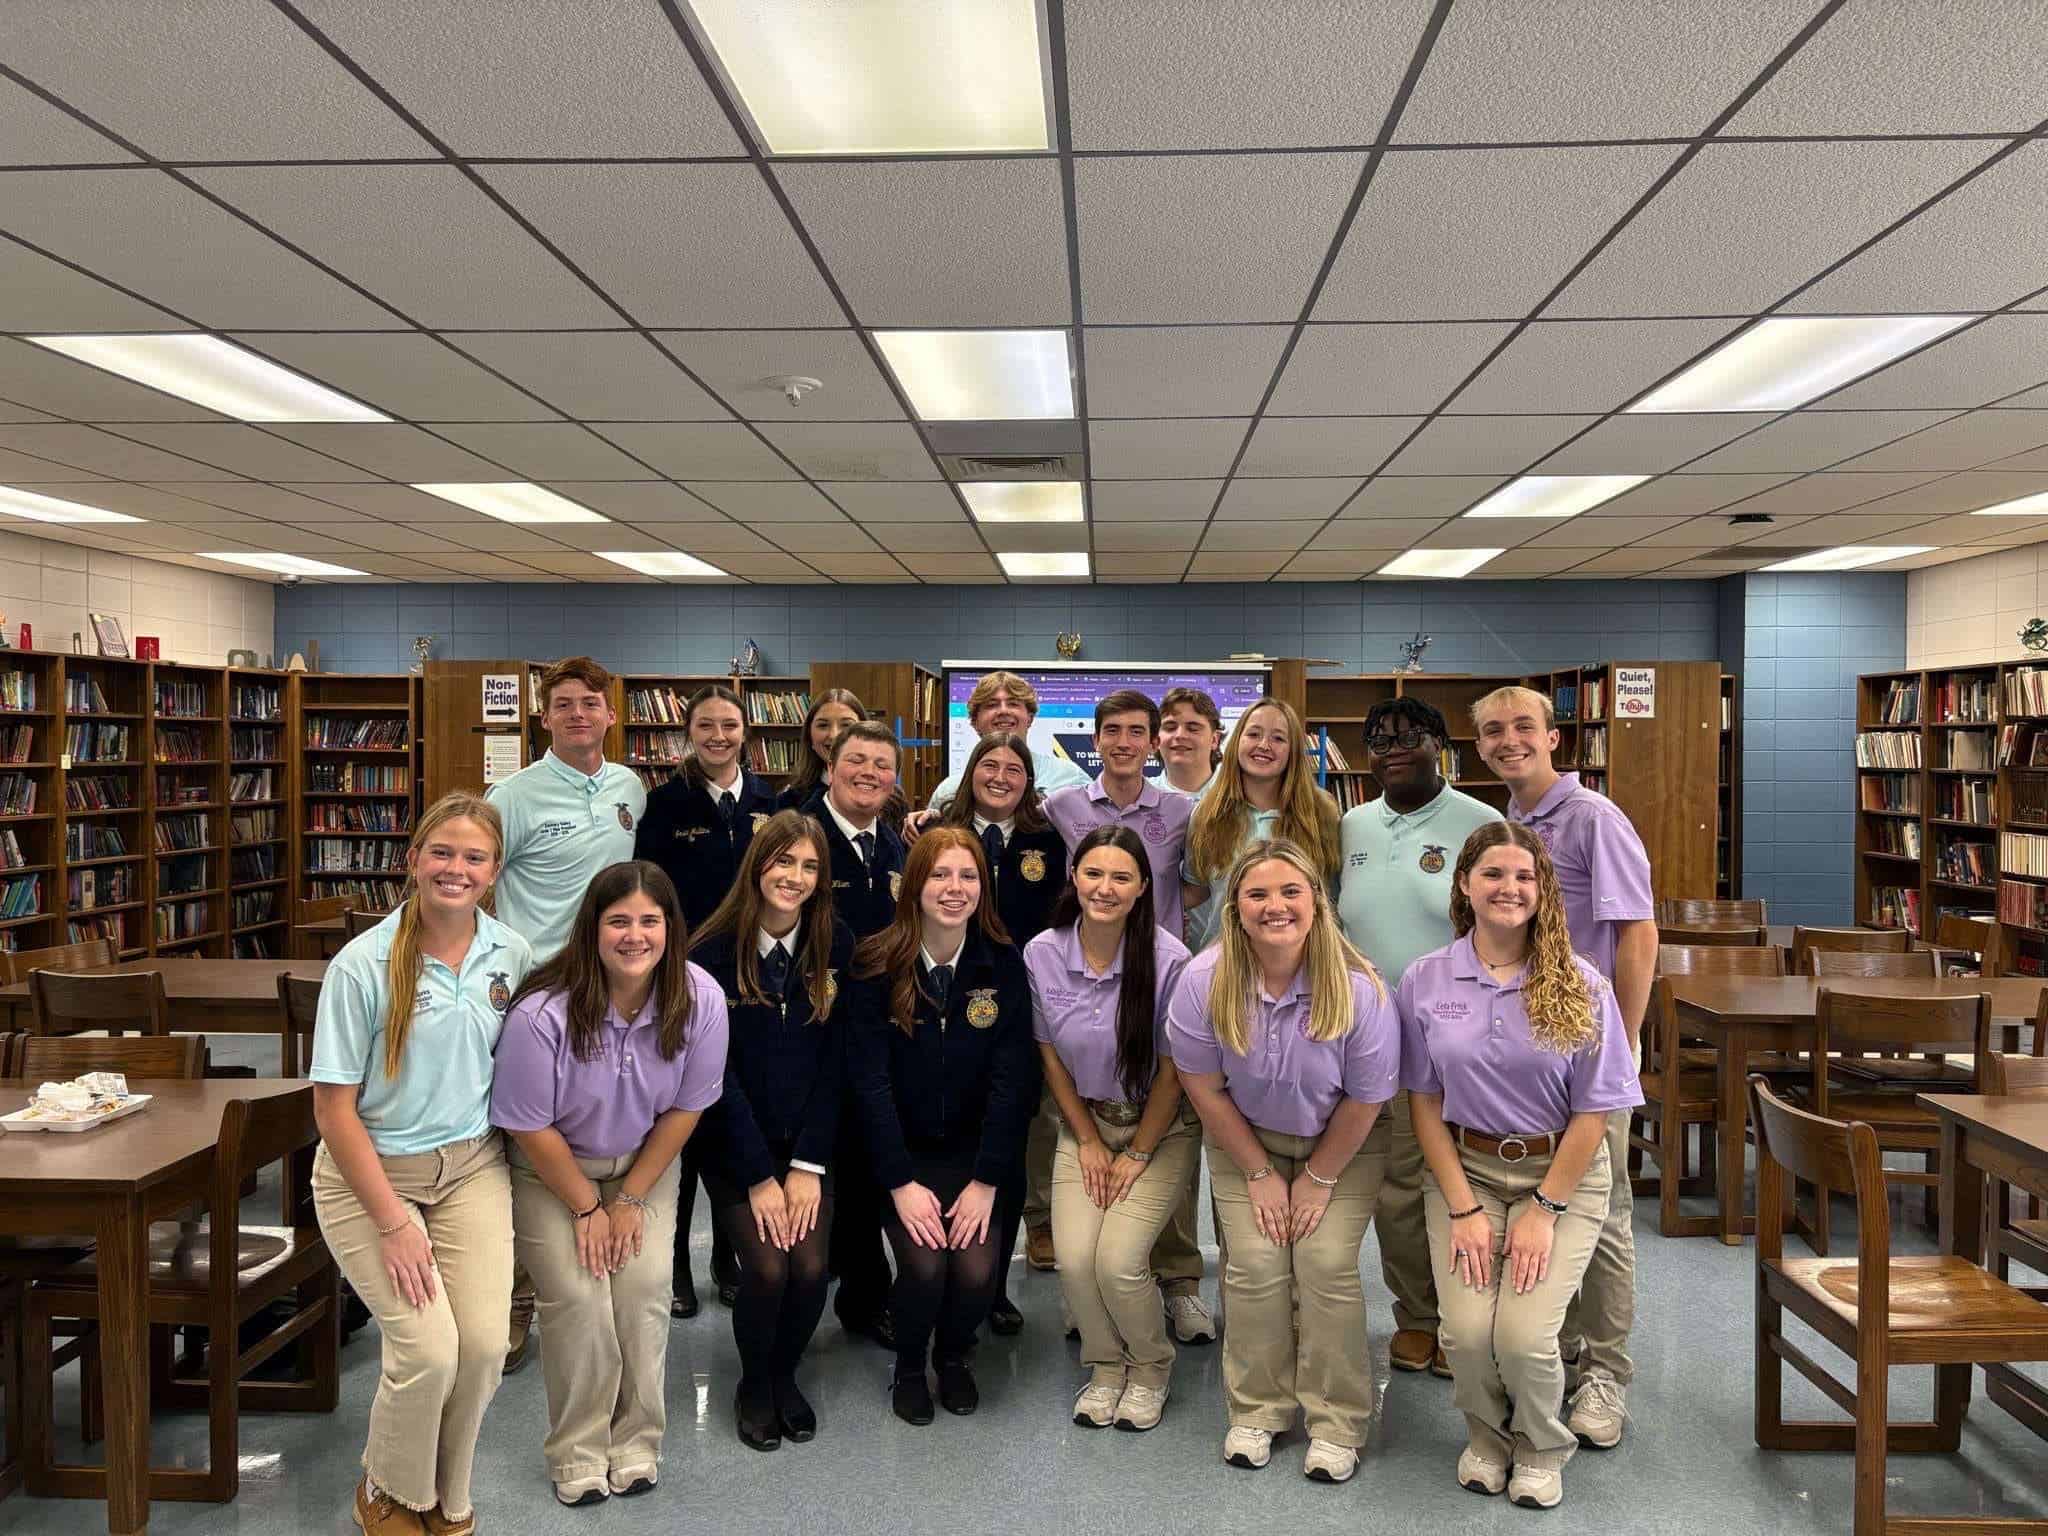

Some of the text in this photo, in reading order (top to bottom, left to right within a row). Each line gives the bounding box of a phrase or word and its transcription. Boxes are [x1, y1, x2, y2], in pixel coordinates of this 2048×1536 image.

[1620, 671, 1651, 683] Quiet,
[486, 679, 516, 690] Non-
[1617, 684, 1653, 695] Please!
[484, 691, 518, 705] Fiction
[1075, 751, 1086, 759] TO
